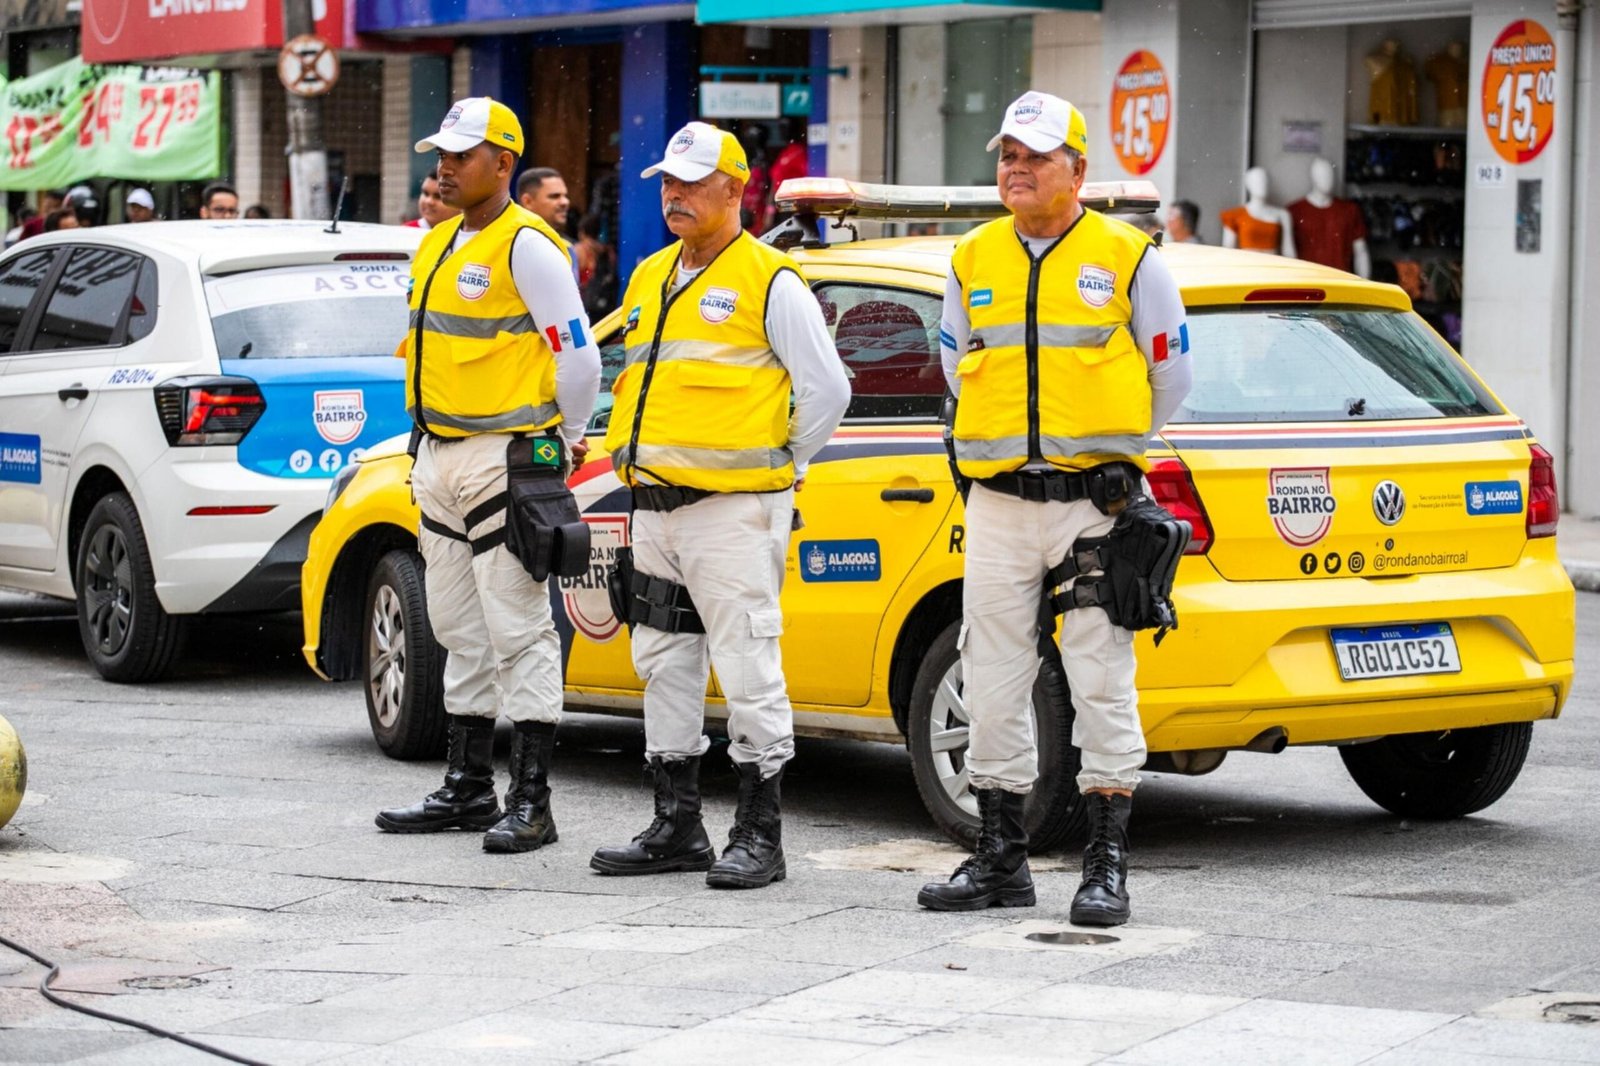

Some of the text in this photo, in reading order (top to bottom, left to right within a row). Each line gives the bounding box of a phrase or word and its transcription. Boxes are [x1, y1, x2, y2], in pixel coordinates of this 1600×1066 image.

[350, 265, 399, 273] RONDA
[457, 274, 491, 288] BAIRRO
[1078, 280, 1115, 295] BAIRRO
[700, 298, 735, 313] BAIRRO
[108, 369, 158, 384] RB-0014
[316, 411, 365, 423] BAIRRO
[3, 447, 37, 465] ALAGOAS
[1276, 485, 1326, 496] RONDA NO
[1486, 490, 1519, 502] ALAGOAS
[1267, 496, 1336, 515] BAIRRO
[828, 552, 877, 565] ALAGOAS
[1373, 551, 1469, 572] @rondanobairroal
[1347, 639, 1450, 674] RGU1C52
